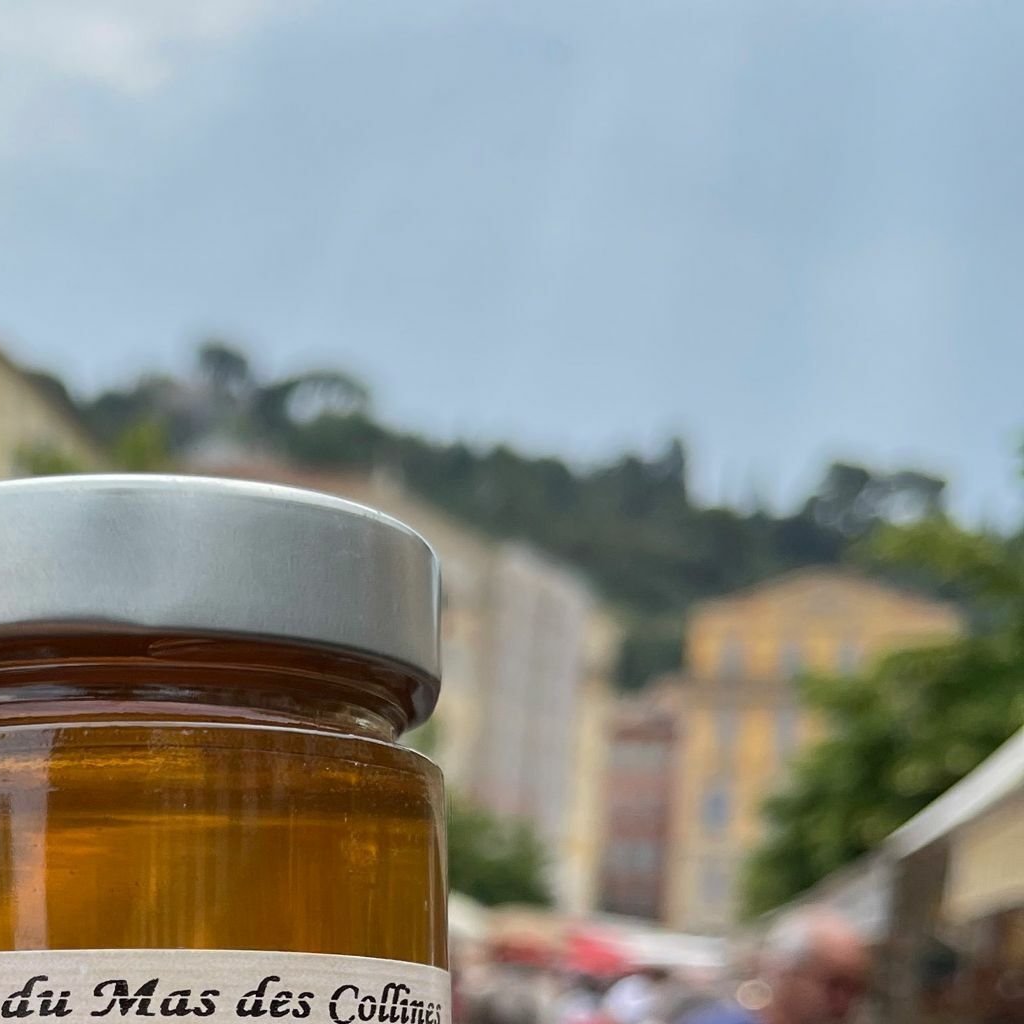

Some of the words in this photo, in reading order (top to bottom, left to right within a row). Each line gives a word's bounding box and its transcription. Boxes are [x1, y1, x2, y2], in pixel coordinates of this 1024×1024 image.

[0, 974, 74, 1019] du
[89, 977, 221, 1018] Mas
[235, 974, 315, 1019] des
